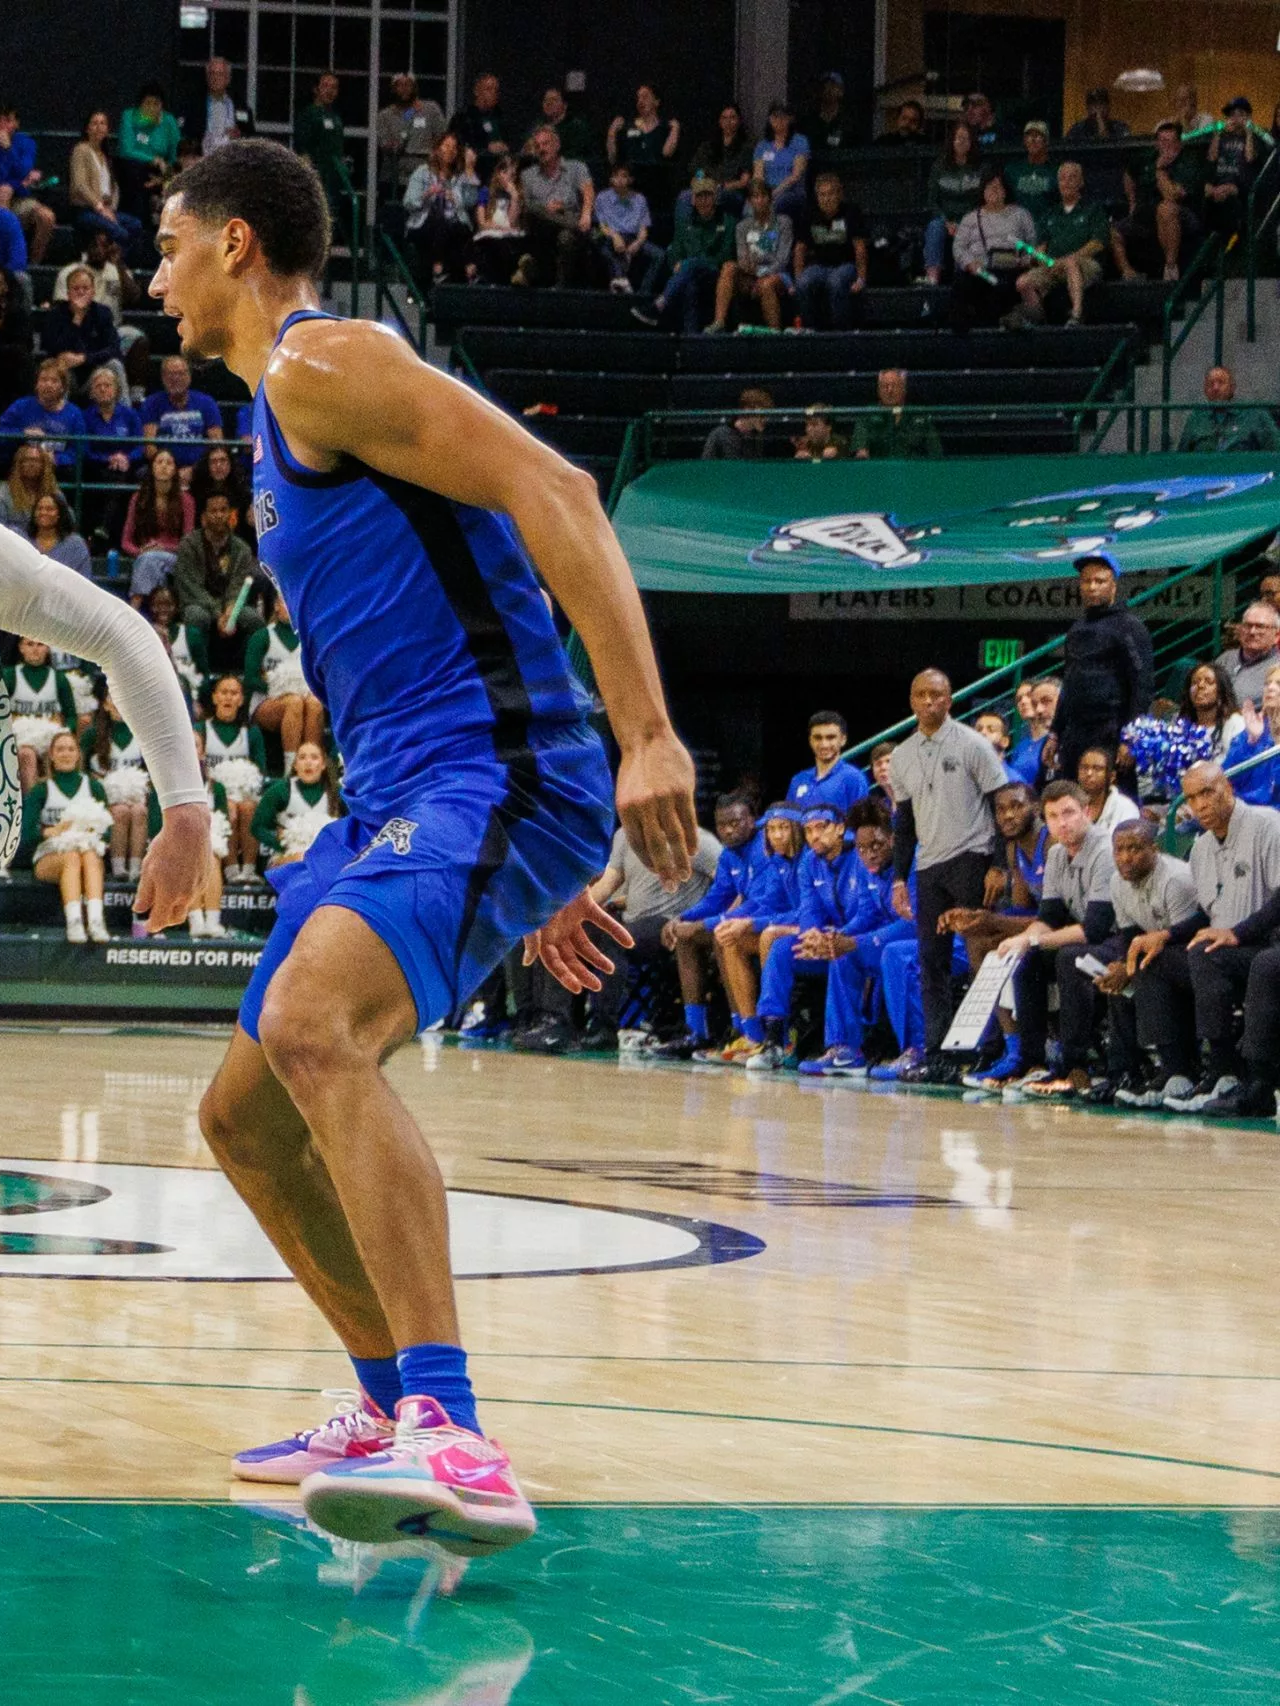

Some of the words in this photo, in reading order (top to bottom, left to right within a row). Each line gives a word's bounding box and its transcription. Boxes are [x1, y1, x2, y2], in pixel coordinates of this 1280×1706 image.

[985, 585, 1081, 608] COACH
[984, 639, 1018, 668] EXIT
[106, 949, 192, 965] RESERVED
[195, 951, 228, 967] FOR
